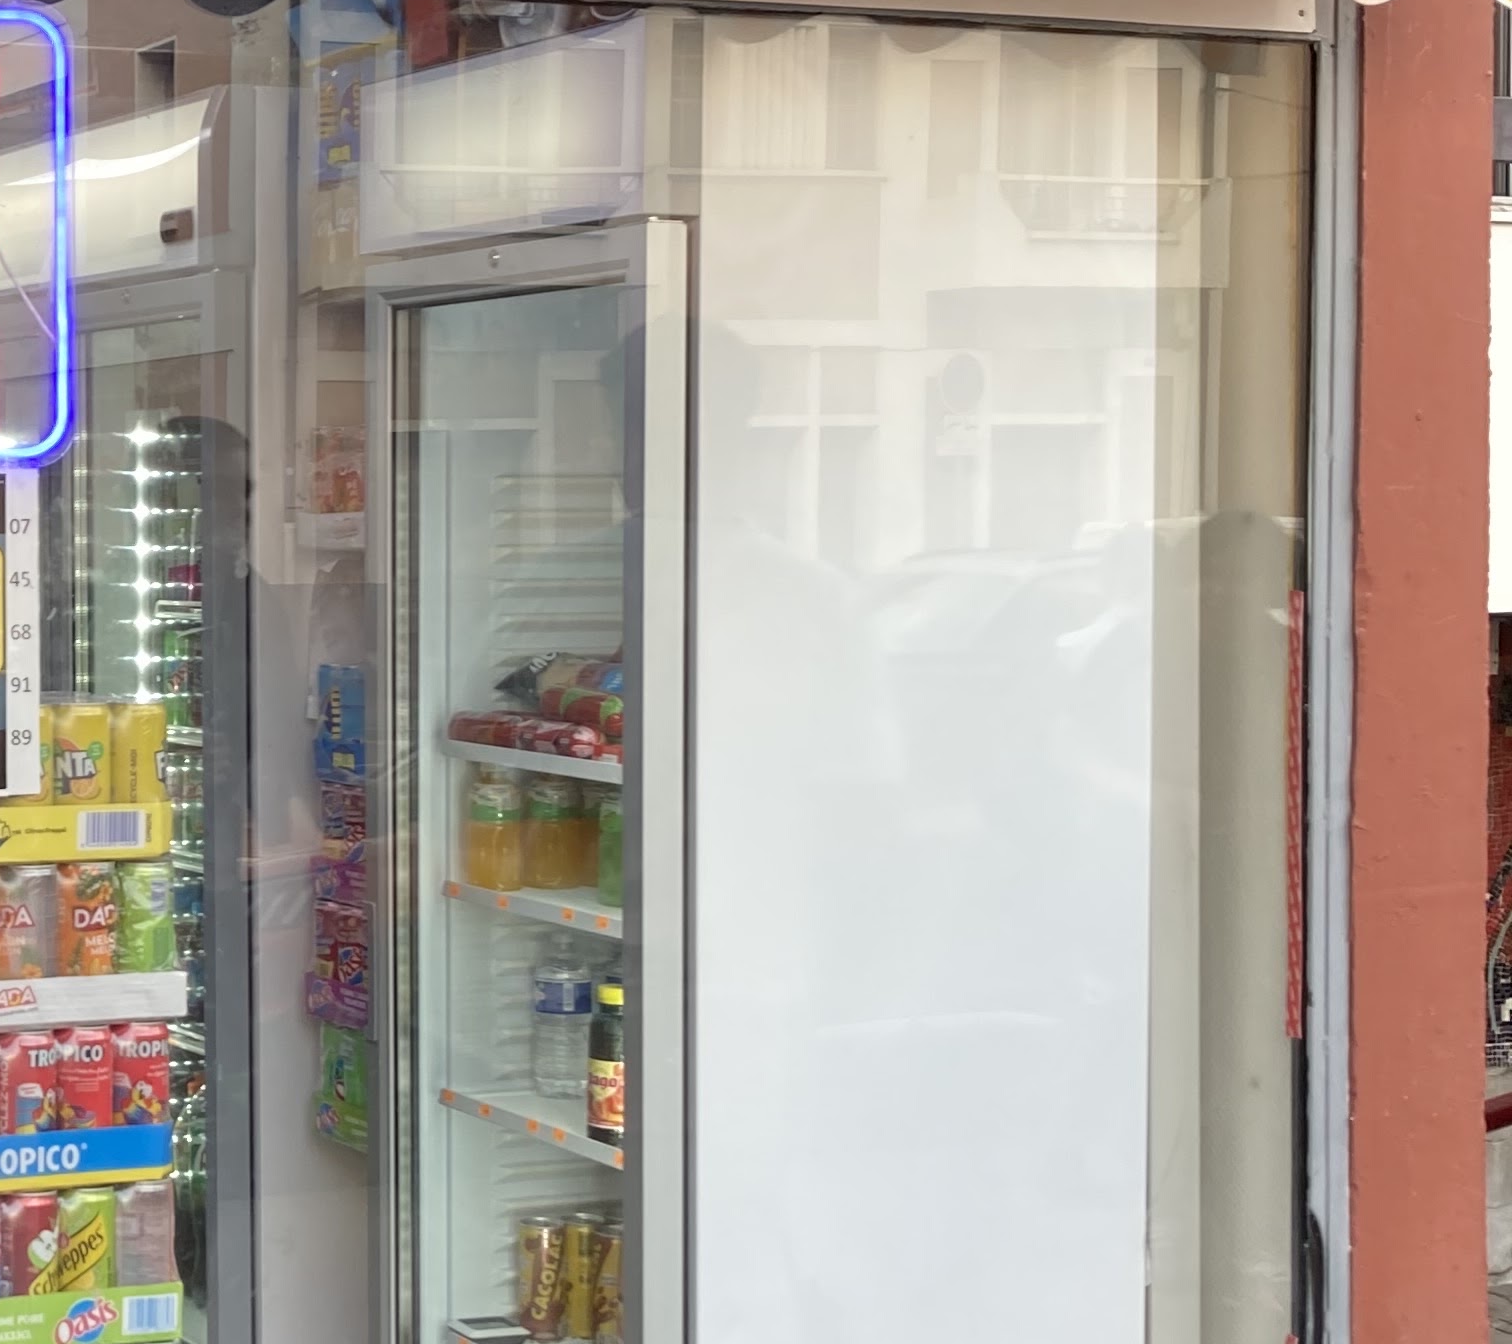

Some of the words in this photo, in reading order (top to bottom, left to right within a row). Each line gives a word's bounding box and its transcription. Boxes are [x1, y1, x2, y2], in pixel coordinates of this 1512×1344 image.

[9, 518, 31, 534] 07
[9, 571, 31, 587] 45
[11, 624, 32, 640] 68
[11, 677, 32, 693] 91
[11, 729, 32, 746] 89
[531, 1233, 564, 1321] CACOLAC
